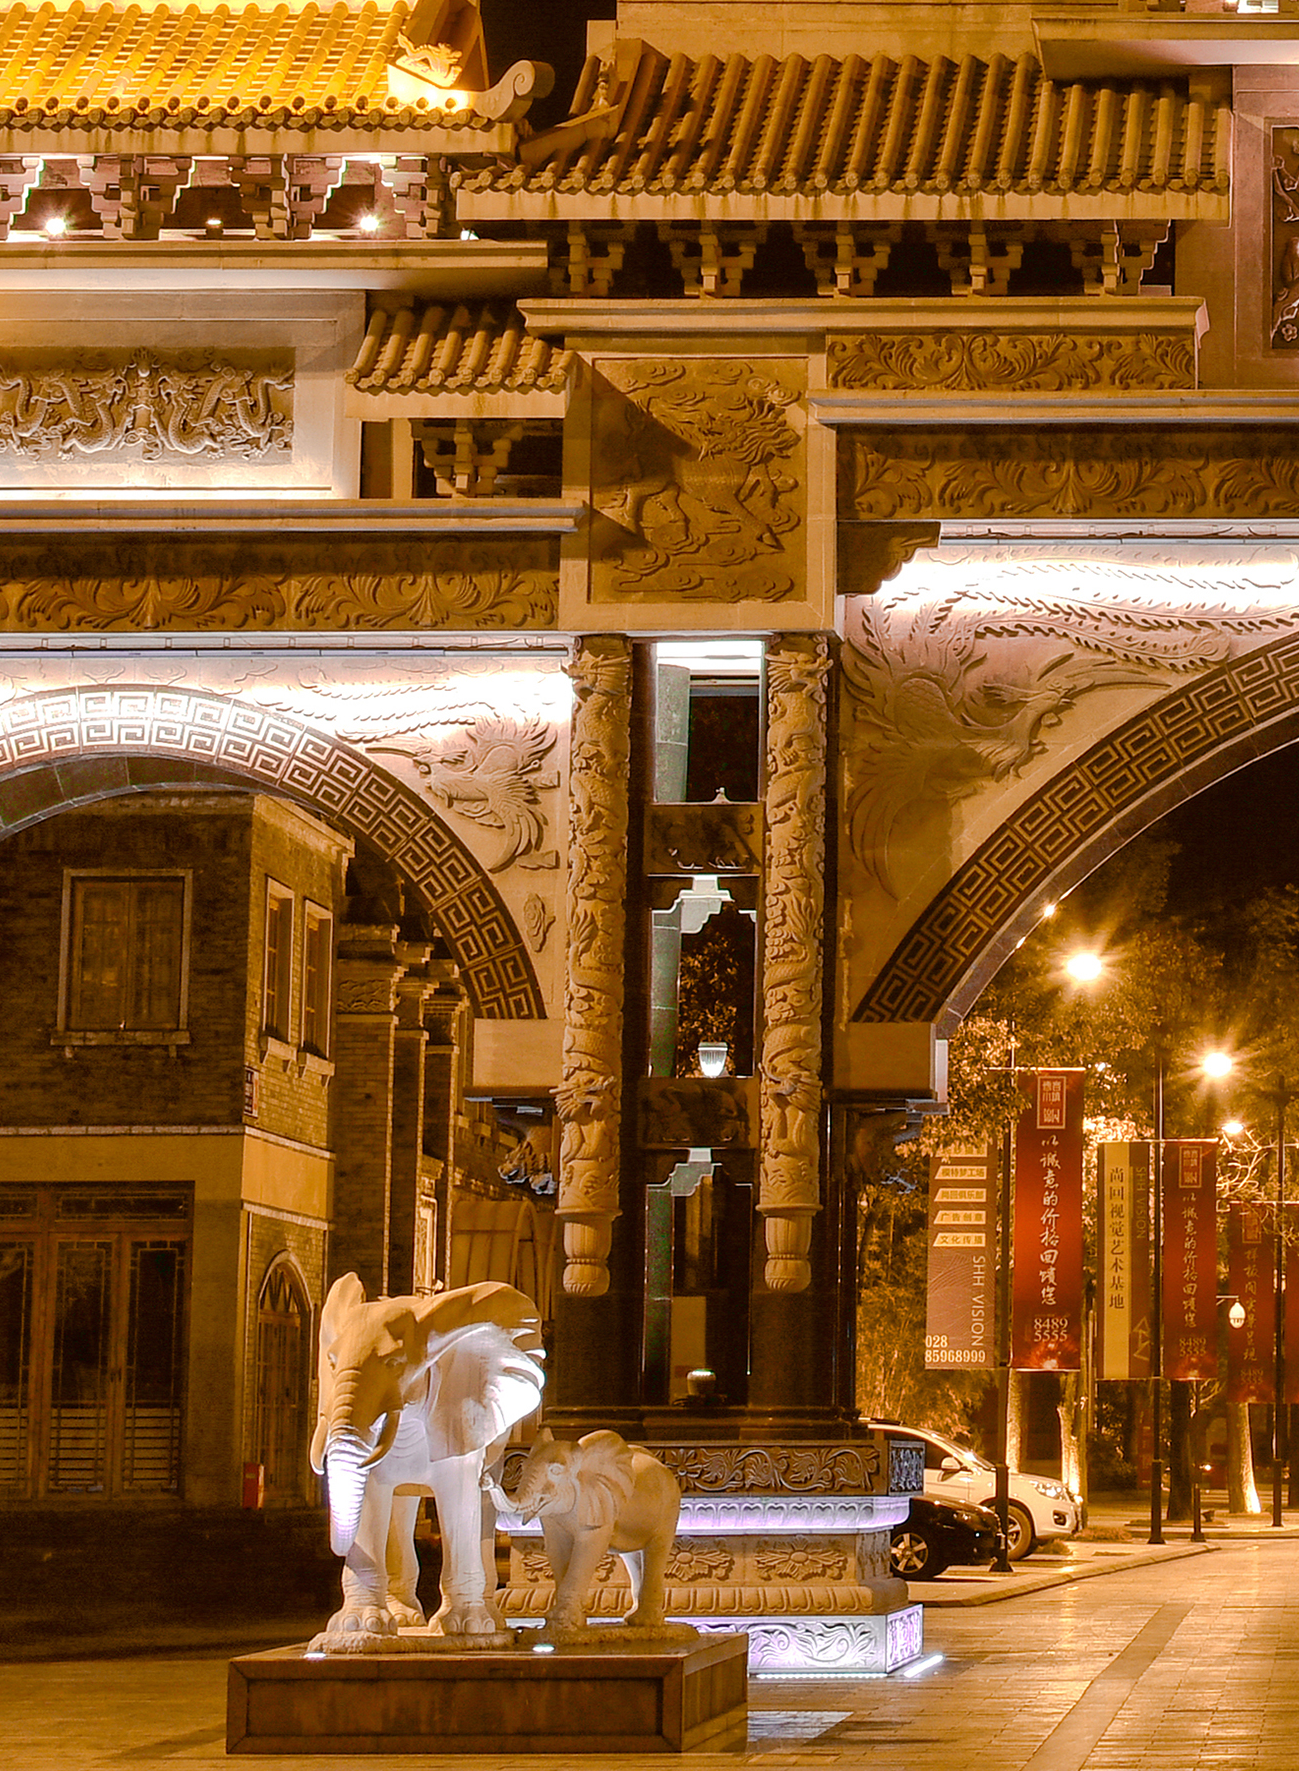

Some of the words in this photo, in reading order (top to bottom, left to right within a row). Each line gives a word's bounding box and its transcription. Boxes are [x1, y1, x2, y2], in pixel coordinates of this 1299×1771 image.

[1135, 1166, 1147, 1192] SHH
[940, 1212, 983, 1222] 广告创意
[1039, 1134, 1061, 1306] 以诚意的价格回馈您
[1135, 1197, 1147, 1239] VISION
[940, 1235, 983, 1245] 文化传播
[1109, 1166, 1125, 1310] 尚回视觉艺术基地
[972, 1255, 986, 1286] SHH
[970, 1294, 985, 1346] VISION
[1033, 1317, 1069, 1330] 8489
[925, 1334, 948, 1348] 028
[1033, 1329, 1068, 1343] 5555
[1179, 1337, 1207, 1347] 8489
[924, 1349, 986, 1363] 85968999
[1179, 1346, 1207, 1357] 5555
